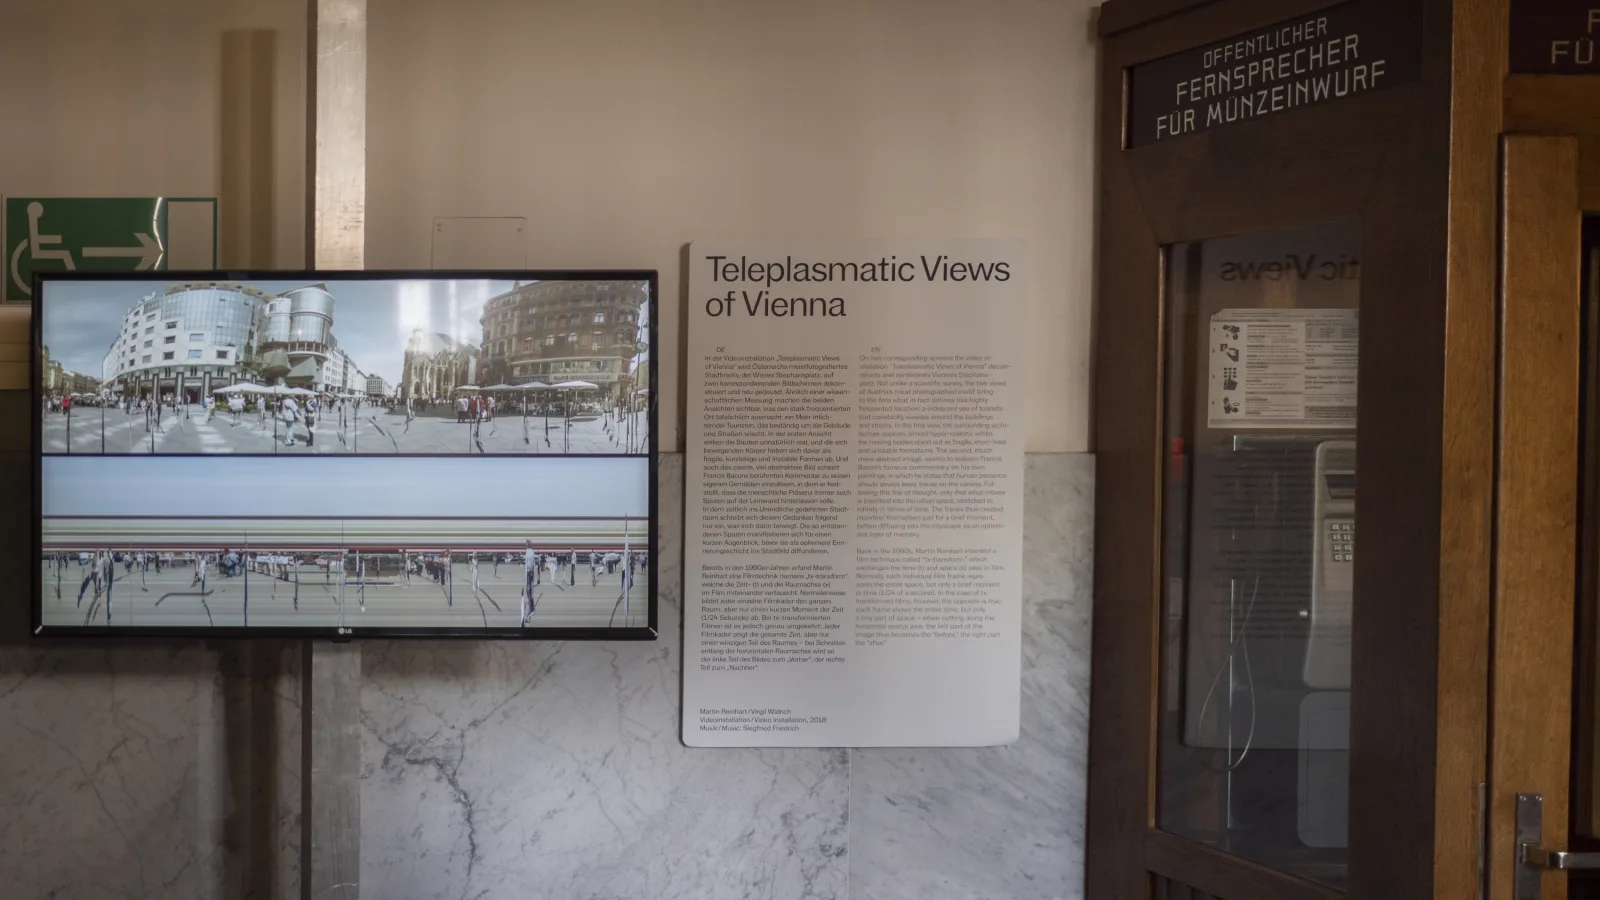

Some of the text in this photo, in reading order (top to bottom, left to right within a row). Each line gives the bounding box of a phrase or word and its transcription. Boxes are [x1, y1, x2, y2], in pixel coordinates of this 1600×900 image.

[1551, 36, 1600, 65] FÜ
[1176, 34, 1359, 105] FERNSPRECHER
[1156, 60, 1385, 139] FÜR MÜNZEINWURF
[706, 256, 1010, 288] Teleplasmatic Views
[706, 290, 846, 317] of Vienna
